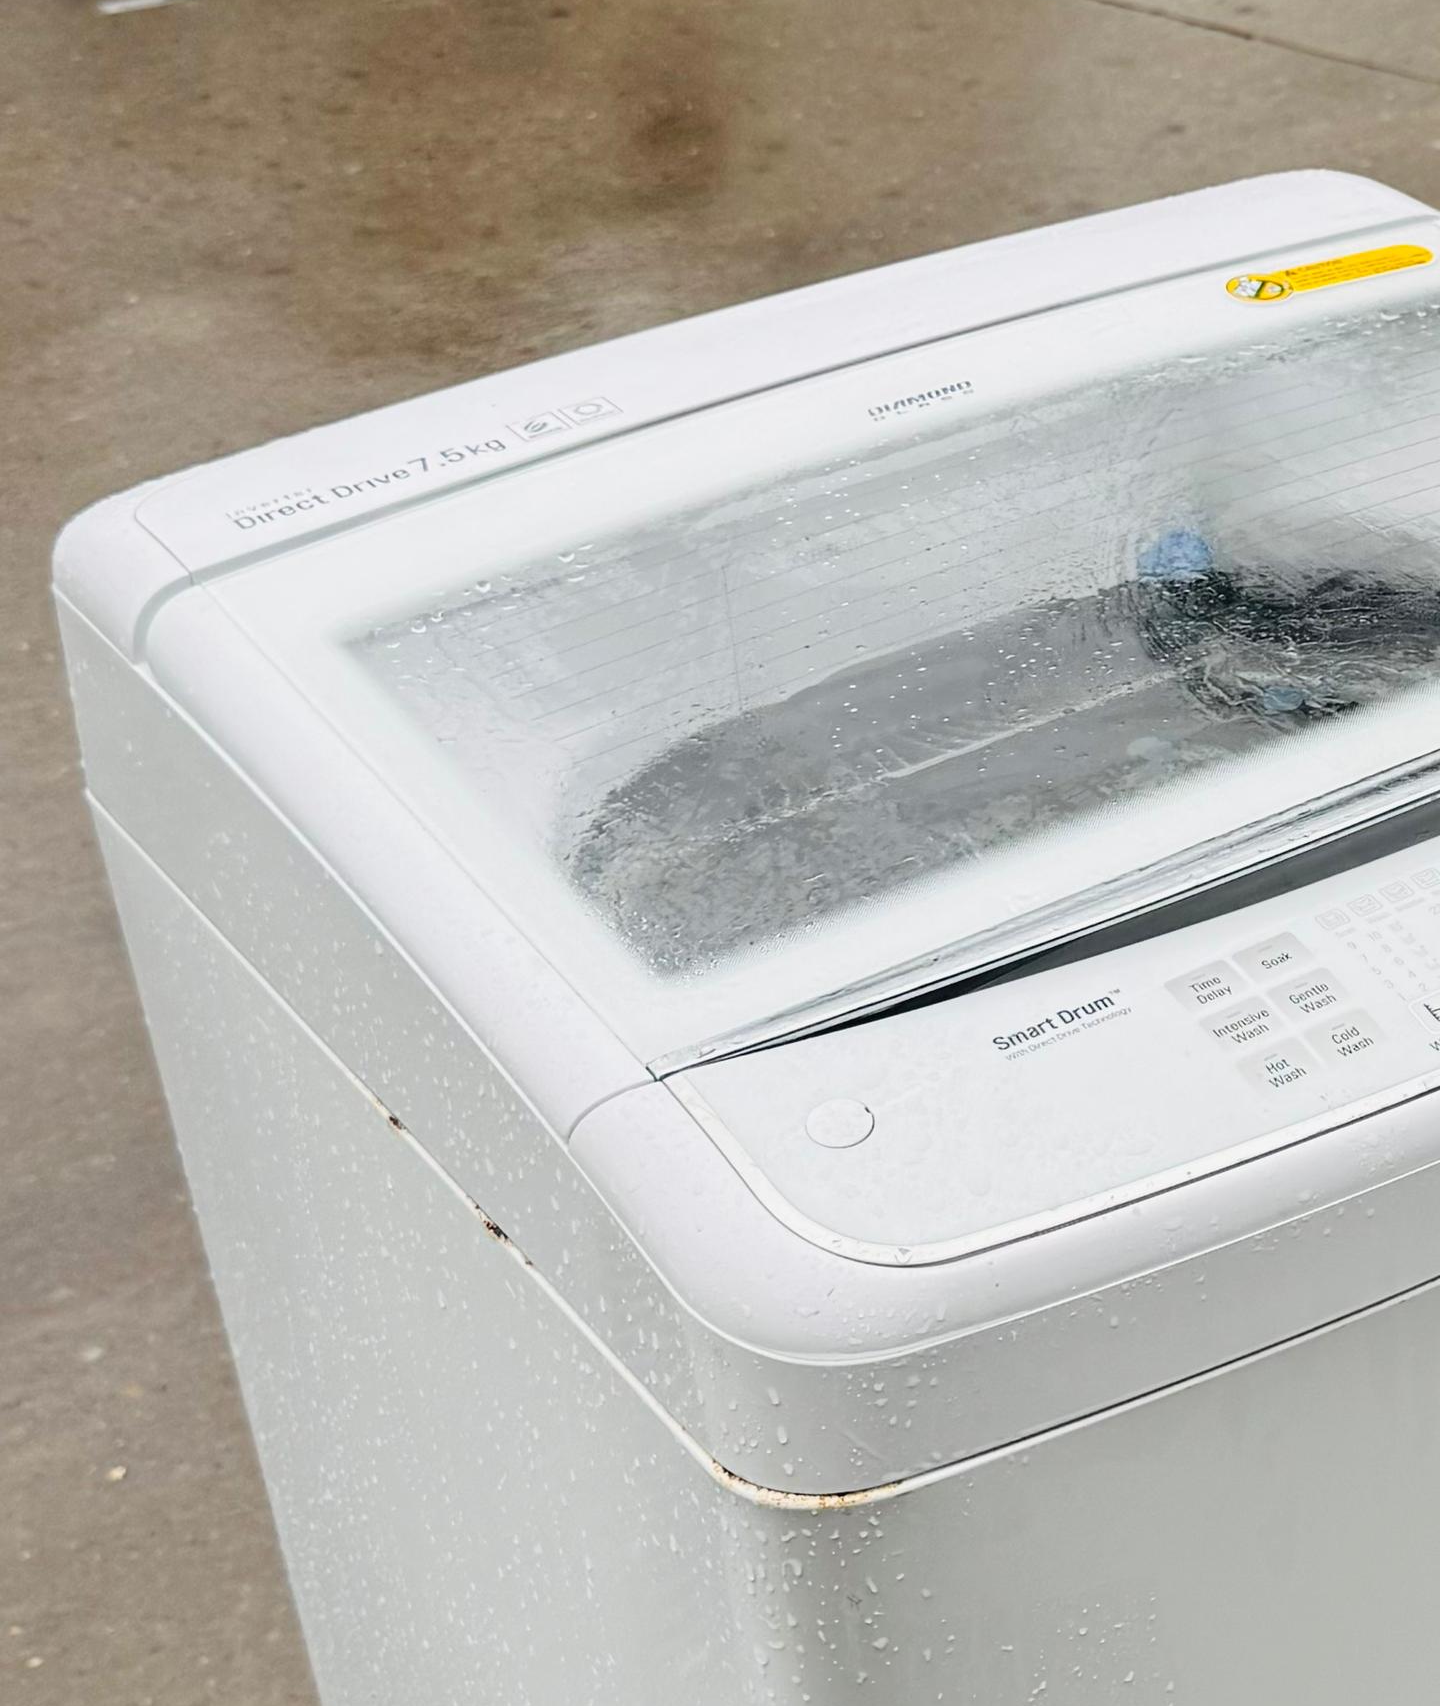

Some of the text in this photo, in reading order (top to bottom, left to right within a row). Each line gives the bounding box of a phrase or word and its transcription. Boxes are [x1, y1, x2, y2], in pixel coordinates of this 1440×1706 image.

[867, 380, 972, 416] DIAMOND
[232, 494, 331, 530] Direct
[331, 468, 411, 499] Drive
[1260, 951, 1294, 971] Soak
[1189, 976, 1222, 994] Time
[1196, 983, 1233, 1006] Delay
[1288, 981, 1330, 1006] Gentle
[1300, 993, 1338, 1014] Wash
[992, 1017, 1058, 1051] Smart
[1212, 1008, 1270, 1039] Intensive
[1231, 1023, 1270, 1045] Wash
[1331, 1025, 1361, 1045] Cold
[1336, 1036, 1375, 1058] Wash
[1265, 1057, 1292, 1076] Hot
[1268, 1067, 1308, 1089] Wash
